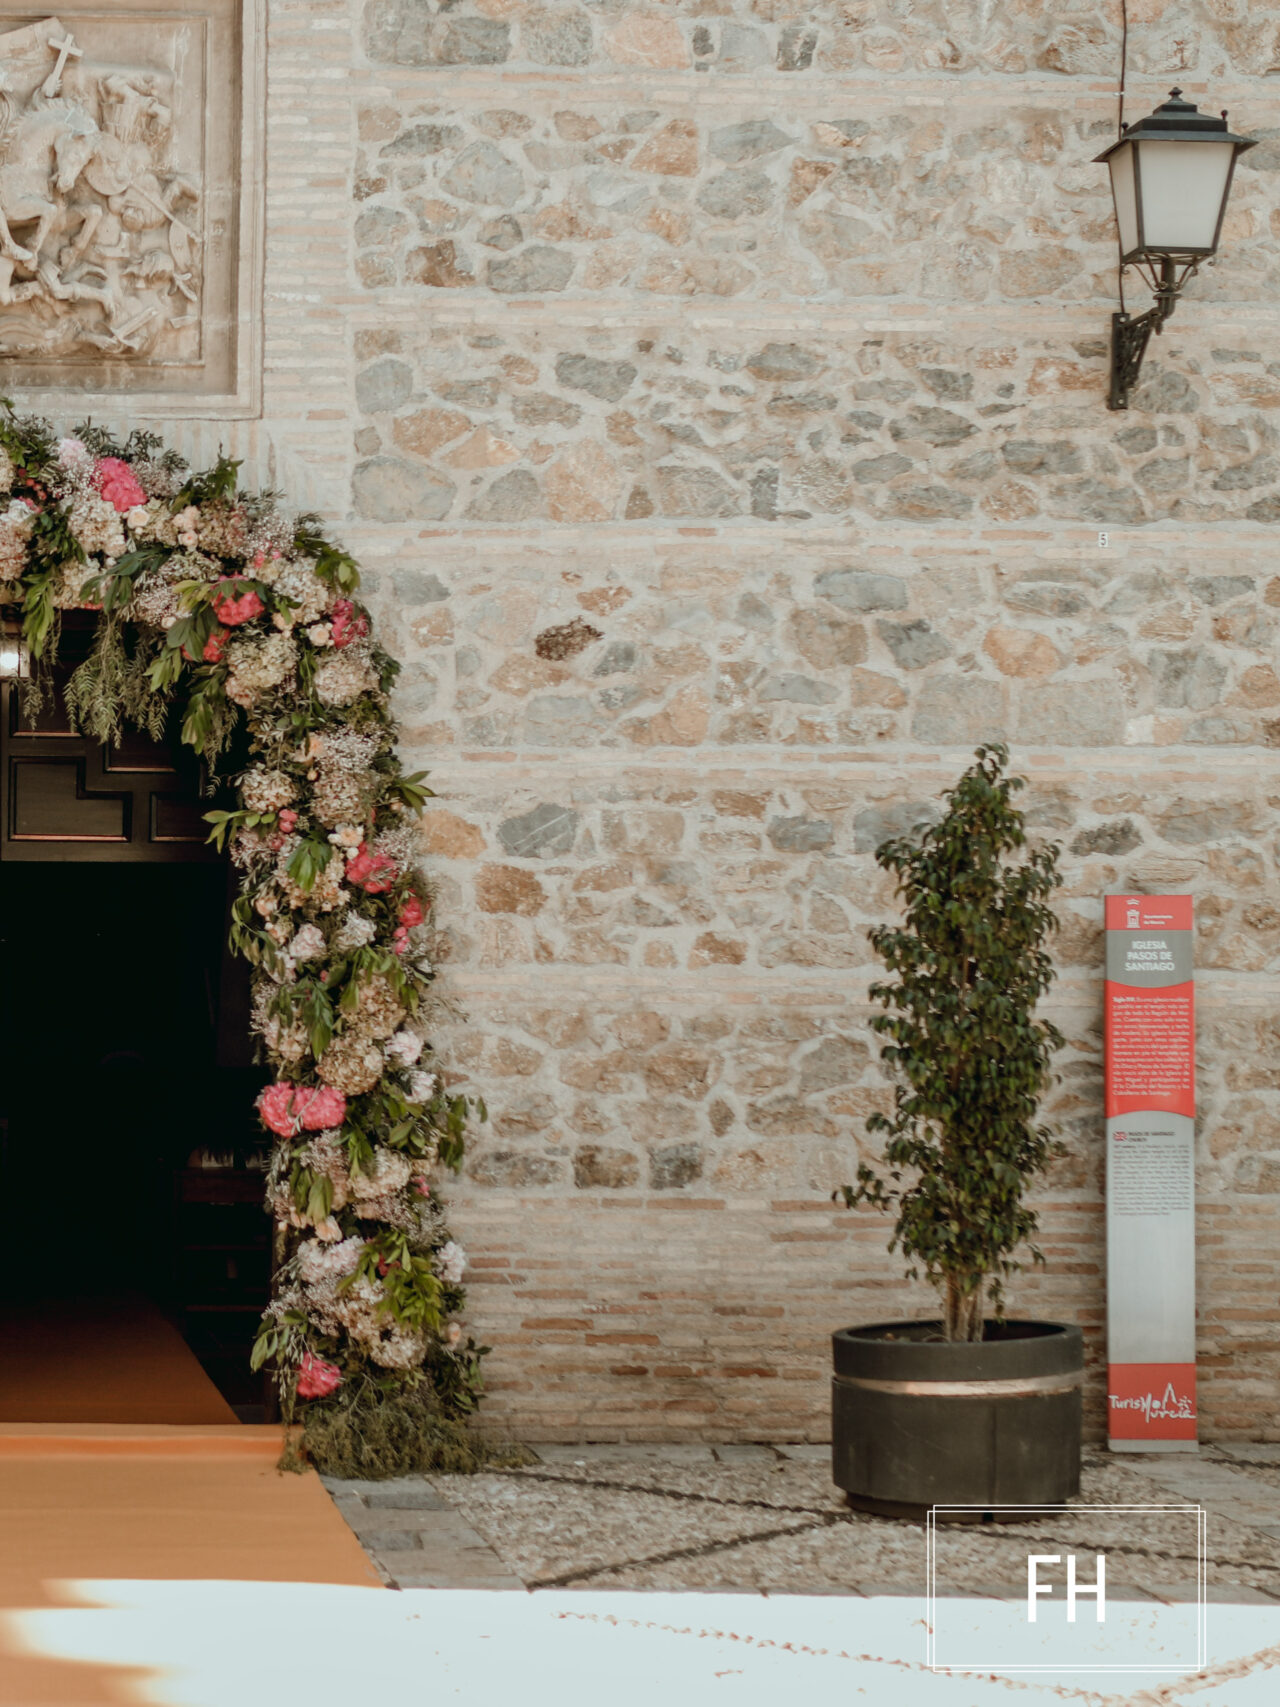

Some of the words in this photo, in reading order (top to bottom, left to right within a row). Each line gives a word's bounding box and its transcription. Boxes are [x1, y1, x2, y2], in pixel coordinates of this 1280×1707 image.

[1100, 533, 1107, 546] 5
[1132, 941, 1167, 949] IGLESIA
[1127, 951, 1158, 960] PASOS
[1160, 951, 1173, 960] DE
[1124, 962, 1175, 971] SANTIAGO
